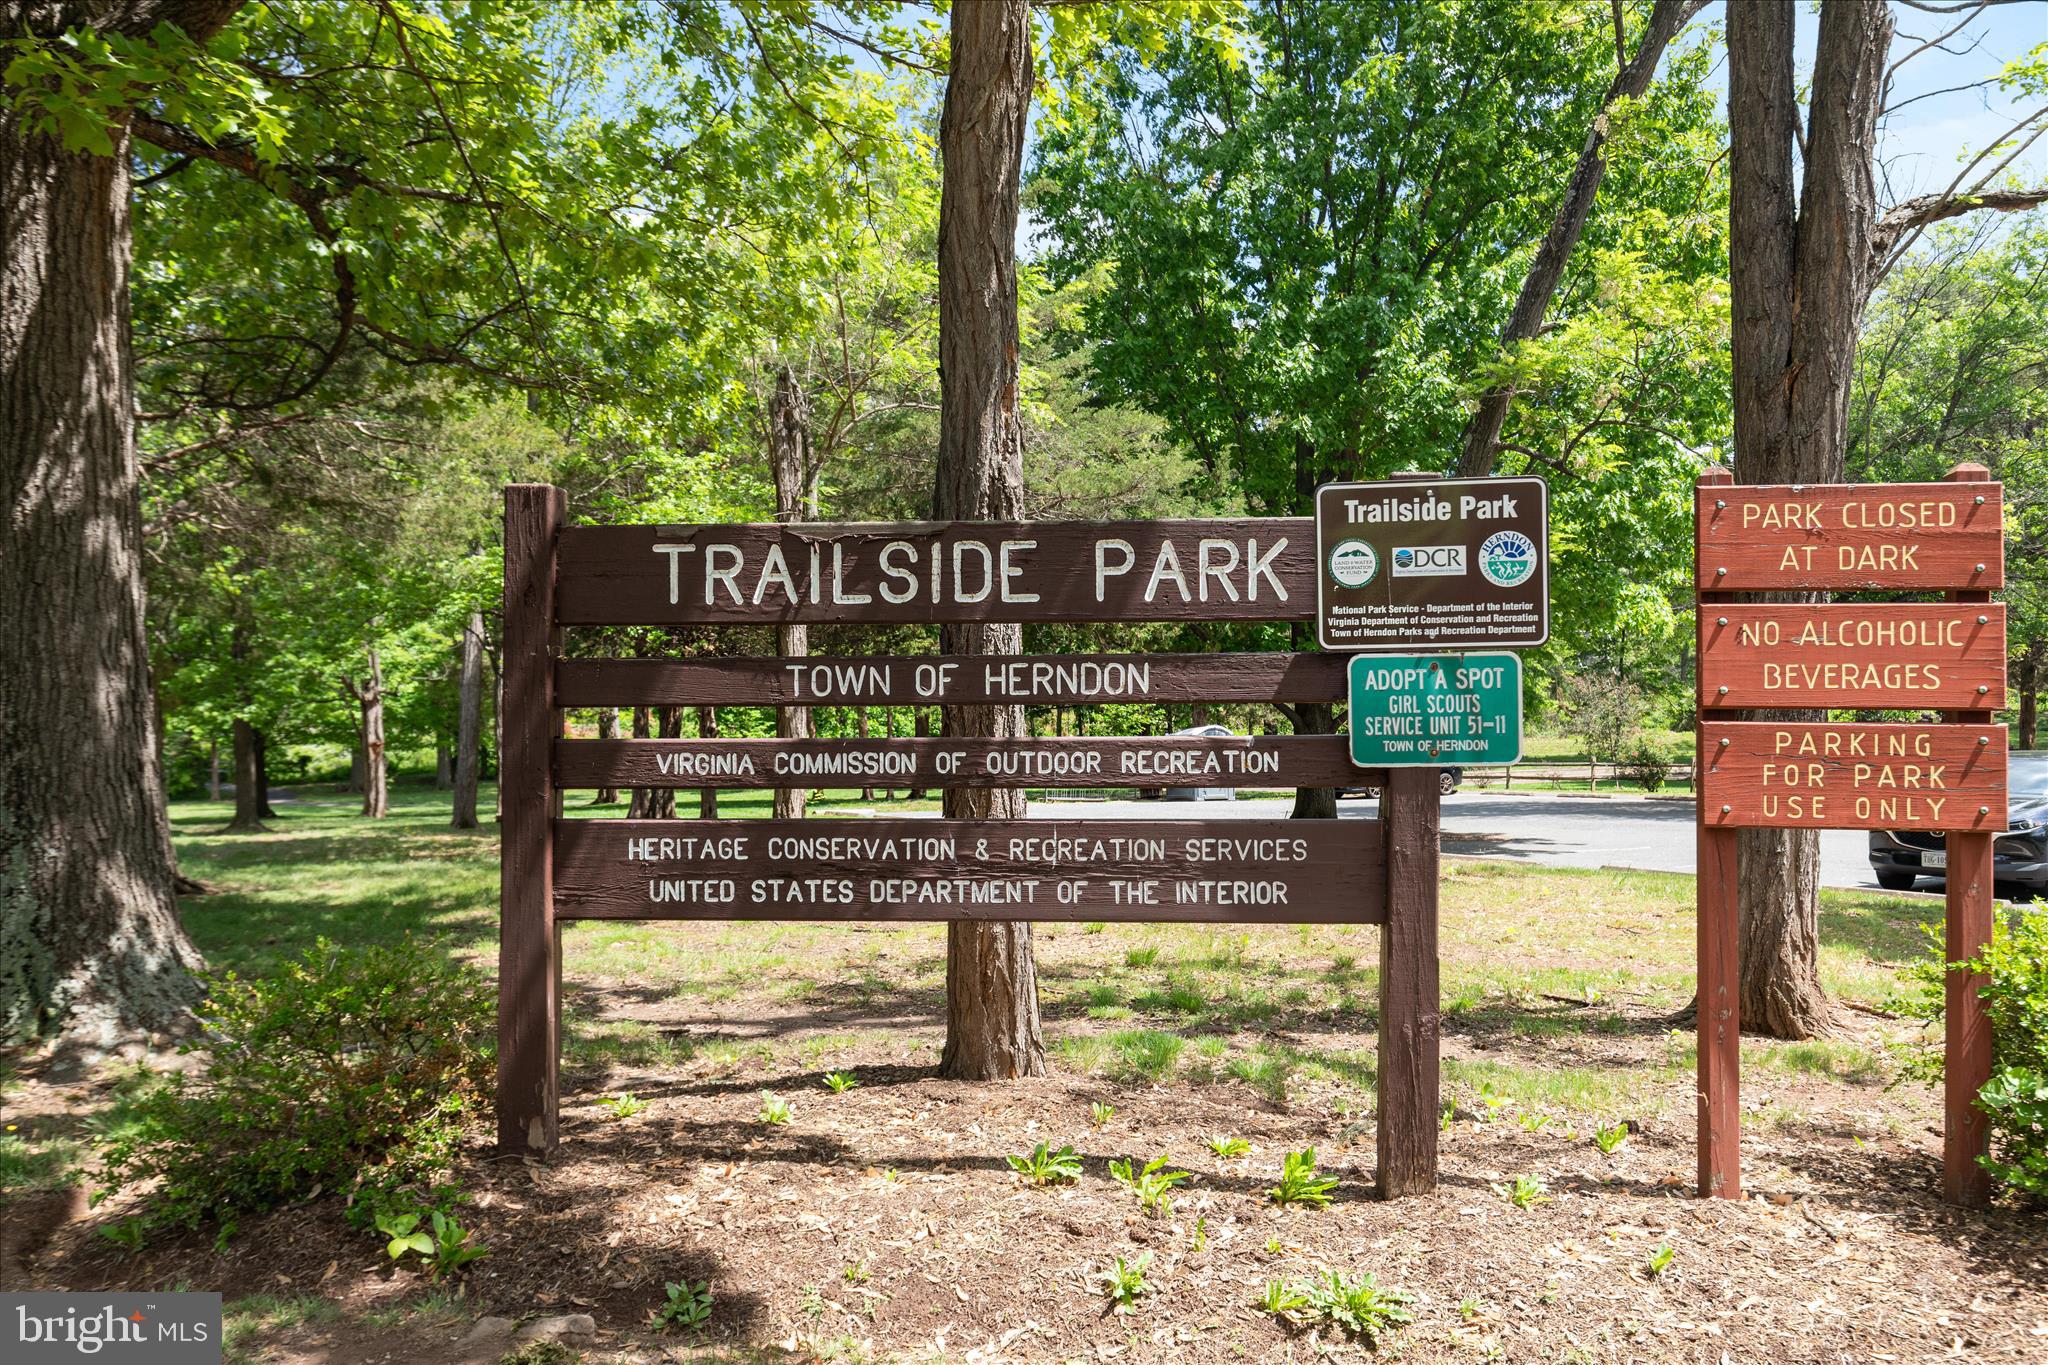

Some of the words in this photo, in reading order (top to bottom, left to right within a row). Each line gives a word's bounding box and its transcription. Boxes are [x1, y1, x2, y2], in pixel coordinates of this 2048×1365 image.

[1343, 496, 1451, 523] Trailside
[1460, 494, 1518, 520] Park
[1743, 503, 1823, 528] PARK
[1842, 501, 1956, 528] CLOSED
[1482, 532, 1534, 553] HERNDON
[1414, 548, 1462, 568] DCR
[1779, 546, 1817, 571] AT
[1839, 545, 1919, 570] DARK
[652, 540, 1040, 605] TRAILSIDE
[1095, 537, 1289, 602] PARK
[1328, 617, 1359, 627] Virginia
[1361, 616, 1408, 627] Department
[1410, 616, 1419, 624] of
[1420, 615, 1474, 624] Conservation
[1476, 614, 1491, 623] and
[1493, 613, 1539, 622] Recreation
[1332, 605, 1366, 614] National
[1368, 605, 1387, 614] Park
[1388, 605, 1419, 614] Service
[1427, 604, 1474, 614] Department
[1476, 603, 1485, 611] of
[1487, 603, 1500, 611] the
[1502, 602, 1534, 611] Interior
[1330, 629, 1351, 637] Town
[1353, 628, 1362, 637] of
[1364, 628, 1398, 637] Herndon
[1399, 627, 1422, 636] Parks
[1424, 627, 1439, 636] and
[1441, 626, 1486, 635] Recreation
[1488, 625, 1536, 635] Department
[1742, 620, 1780, 646] NO
[1799, 620, 1964, 647] ALCOHOLIC
[785, 664, 891, 698] TOWN
[914, 663, 959, 697] OF
[985, 662, 1150, 696] HERNDON
[1364, 669, 1427, 691] ADOPT
[1434, 669, 1447, 690] A
[1456, 667, 1504, 689] SPOT
[1763, 663, 1941, 689] BEVERAGES
[1389, 695, 1420, 714] GIRL
[1427, 694, 1481, 714] SCOUTS
[1365, 716, 1423, 736] SERVICE
[1430, 715, 1461, 735] UNIT
[1468, 715, 1506, 735] 51-11
[1383, 740, 1413, 752] TOWN
[1418, 740, 1432, 752] OF
[1437, 739, 1488, 751] HERNDON
[1775, 732, 1931, 757] PARKING
[655, 753, 755, 775] VIRGINIA
[774, 752, 917, 775] COMMISSION
[935, 752, 967, 774] OF
[986, 751, 1101, 774] OUTDOOR
[1121, 750, 1279, 774] RECREATION
[1763, 764, 1825, 787] FOR
[1854, 765, 1946, 789] PARK
[1763, 796, 1826, 819] USE
[1855, 797, 1946, 821] ONLY
[628, 837, 749, 861] HERITAGE
[768, 837, 955, 860] CONSERVATION
[975, 838, 990, 860] &
[1009, 838, 1165, 861] RECREATION
[1185, 838, 1307, 861] SERVICES
[649, 880, 735, 903] UNITED
[751, 880, 853, 903] STATES
[870, 880, 1039, 904] DEPARTMENT
[1057, 881, 1088, 904] OF
[1109, 880, 1159, 904] THE
[1175, 881, 1288, 905] INTERIOR
